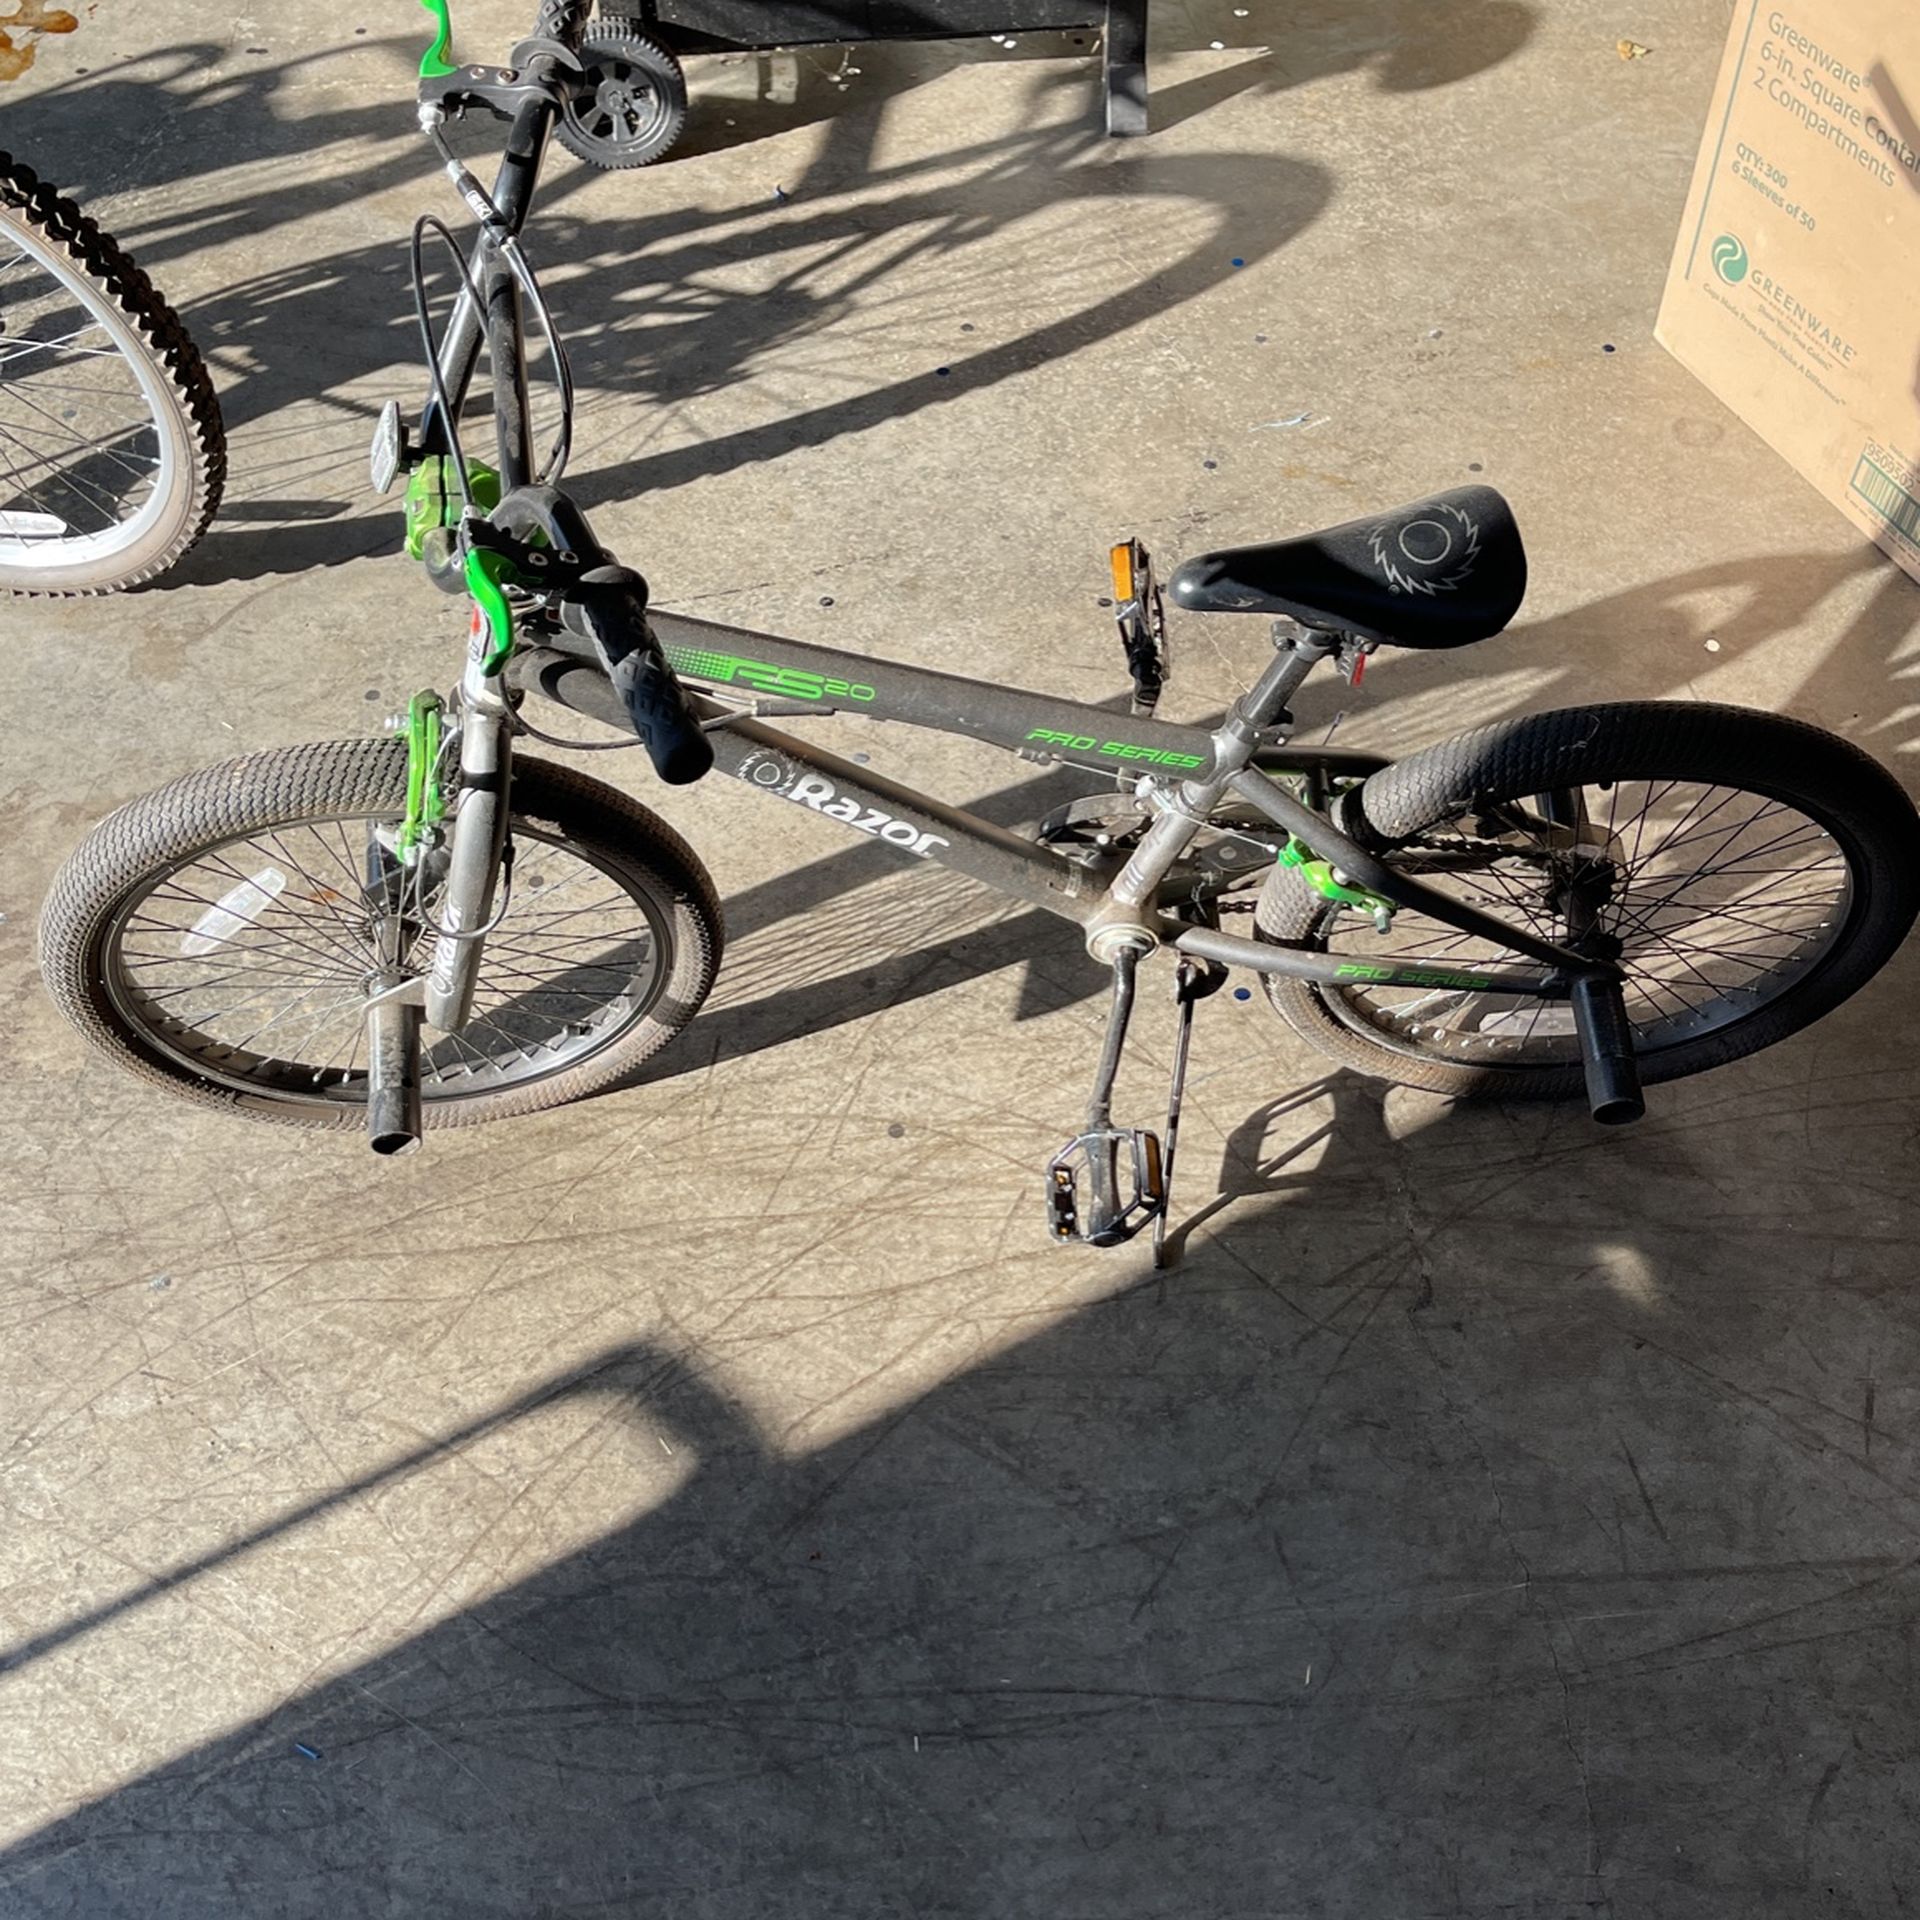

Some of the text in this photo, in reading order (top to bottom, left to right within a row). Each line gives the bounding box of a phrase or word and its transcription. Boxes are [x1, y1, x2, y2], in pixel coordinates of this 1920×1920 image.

[1761, 40, 1796, 81] 6-in.
[1800, 67, 1861, 128] Square
[1753, 66, 1896, 187] 2 Compartments
[1731, 160, 1816, 232] 6 Sleeves of 50
[1736, 142, 1788, 189] QTY: 300
[1025, 728, 1207, 769] PRO SERIES
[787, 772, 950, 859] Razor
[1334, 963, 1492, 990] PRO SERIES
